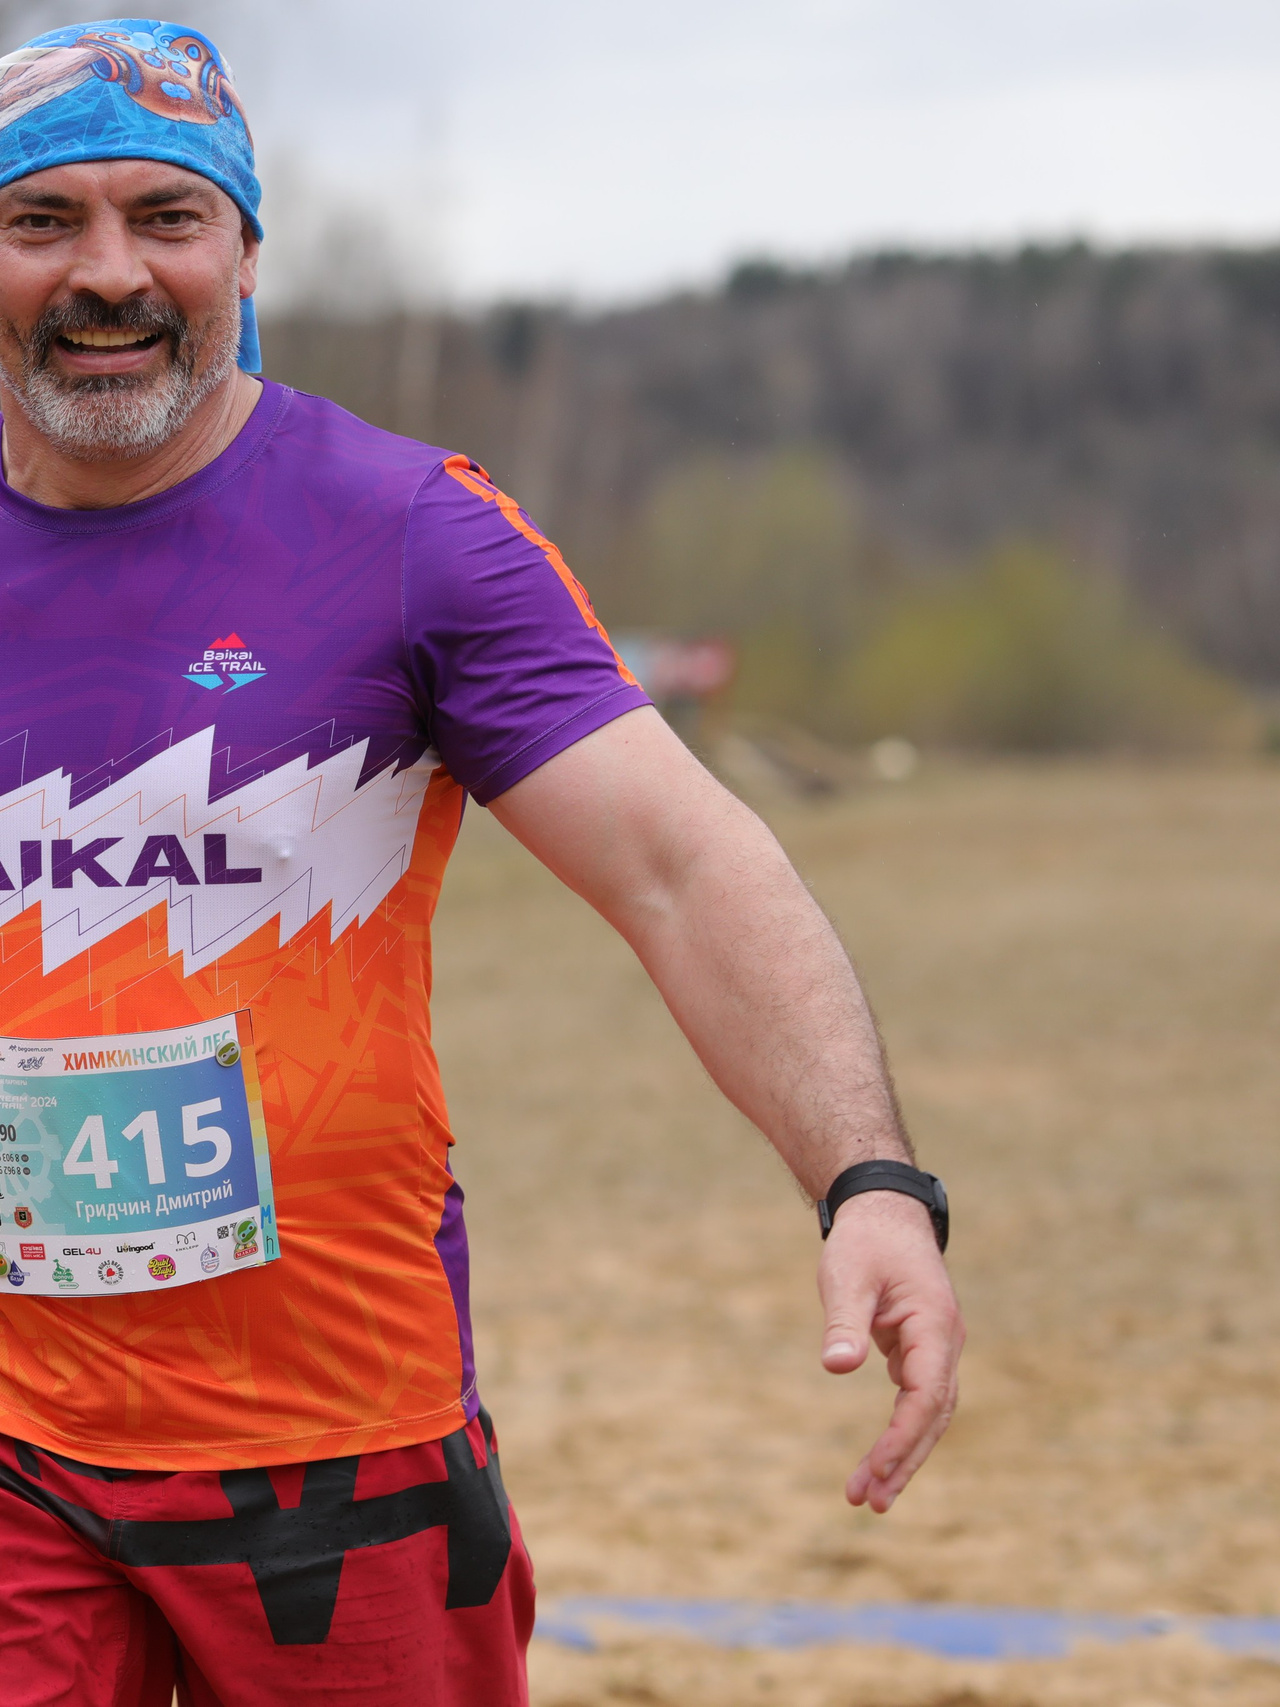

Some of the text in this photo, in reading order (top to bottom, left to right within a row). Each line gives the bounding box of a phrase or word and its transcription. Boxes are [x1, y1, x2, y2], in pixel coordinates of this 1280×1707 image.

[202, 649, 253, 661] Baikal
[188, 660, 267, 673] ICE TRAIL
[61, 1035, 198, 1072] ХИМКИНСКИЙ
[30, 1096, 58, 1108] 2024
[63, 1096, 232, 1189] 415
[76, 1178, 233, 1223] Гридчин Дмитрий
[63, 1247, 102, 1256] GEL4U
